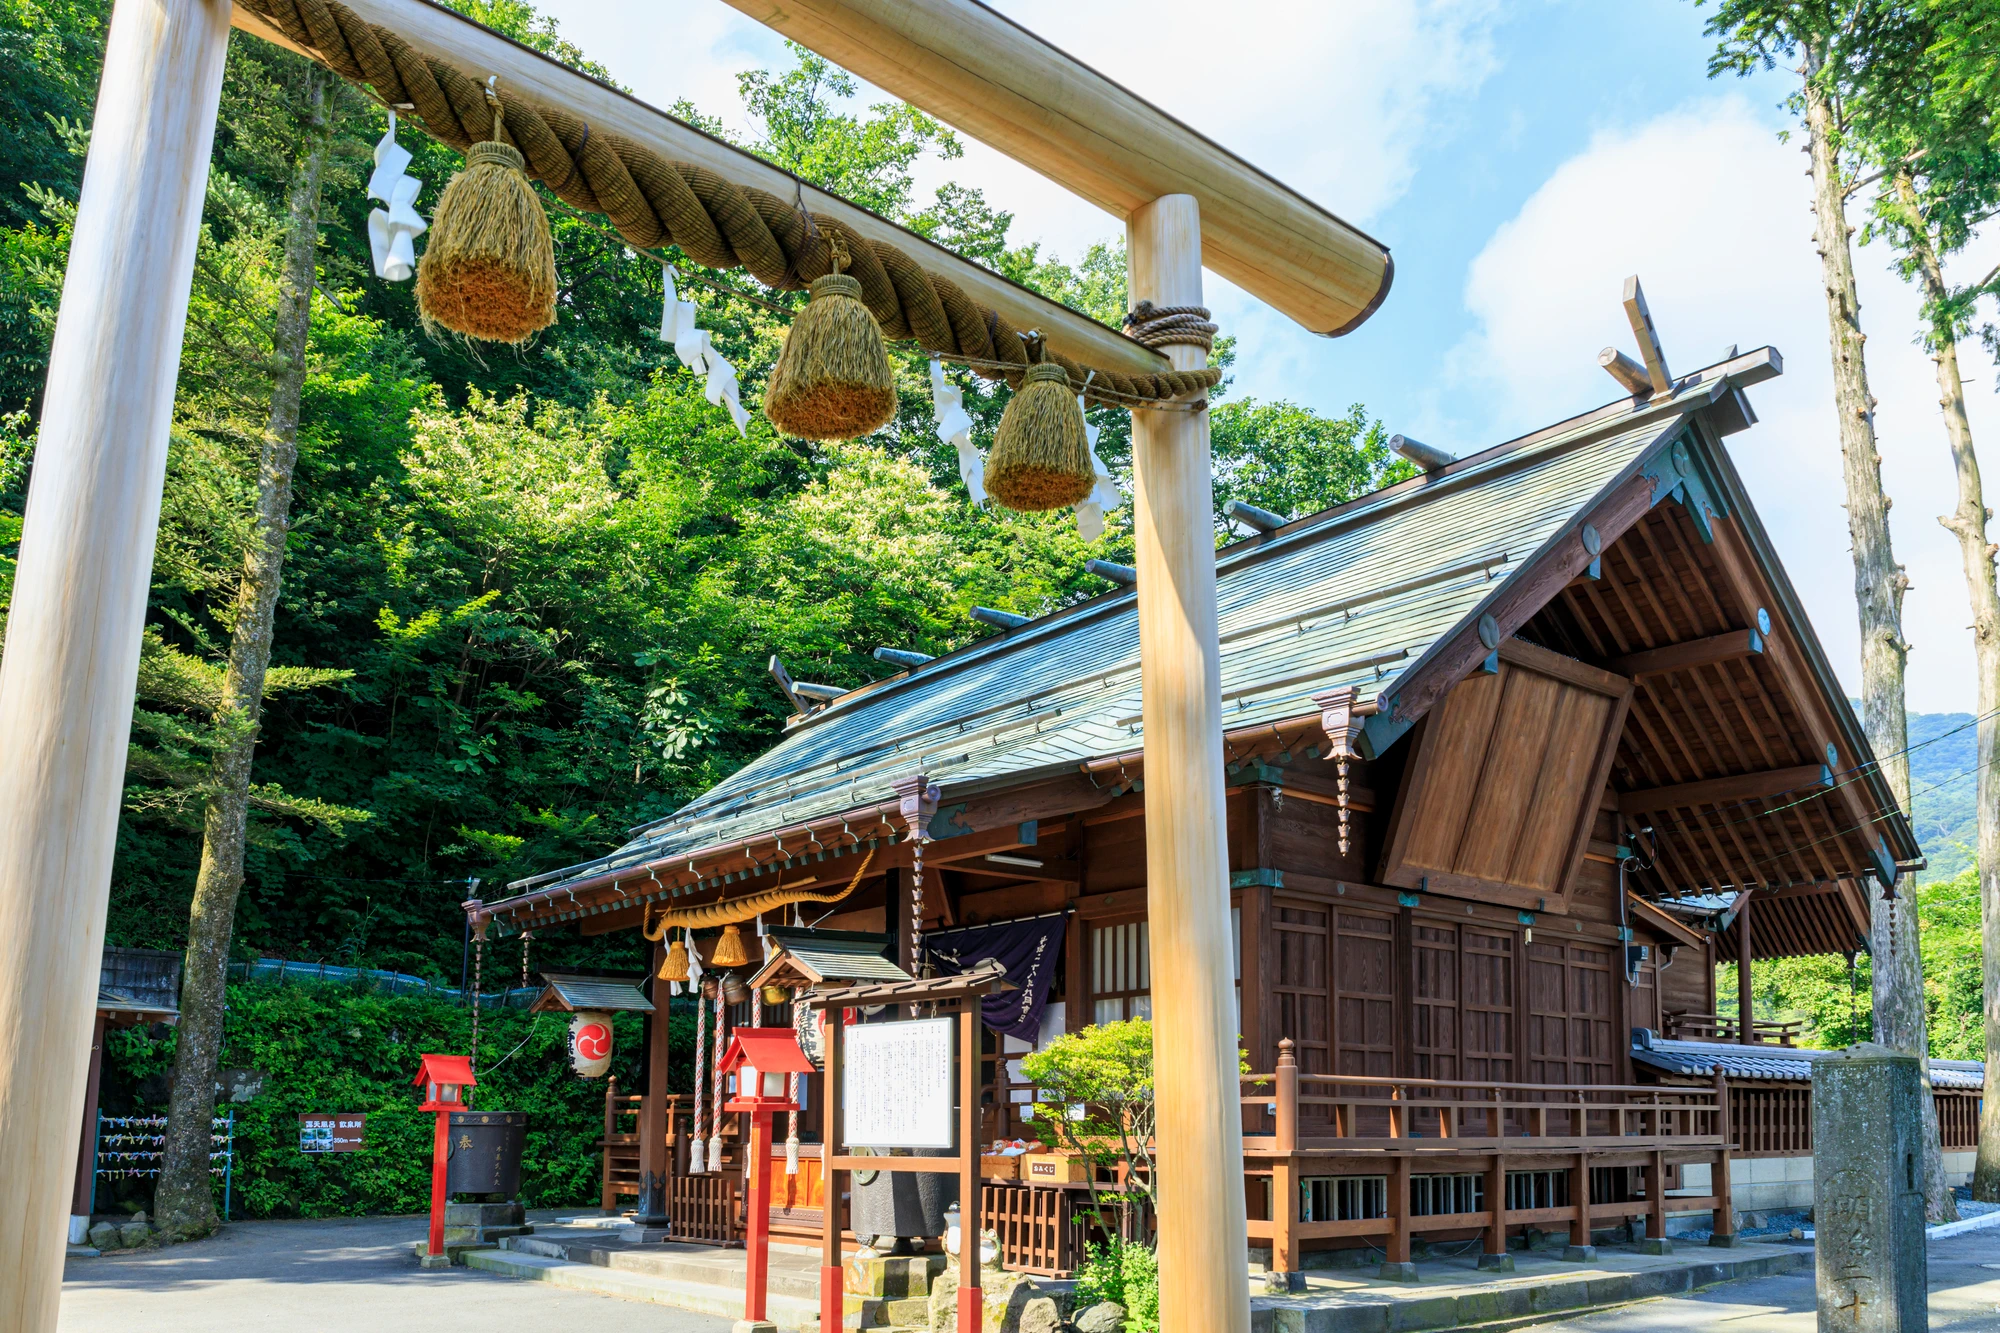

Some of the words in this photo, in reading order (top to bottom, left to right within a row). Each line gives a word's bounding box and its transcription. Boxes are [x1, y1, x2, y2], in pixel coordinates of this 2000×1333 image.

[305, 1120, 336, 1128] 露天風呂
[339, 1120, 362, 1128] 飲泉所
[458, 1134, 474, 1151] 奉
[1033, 1165, 1054, 1173] おみくじ
